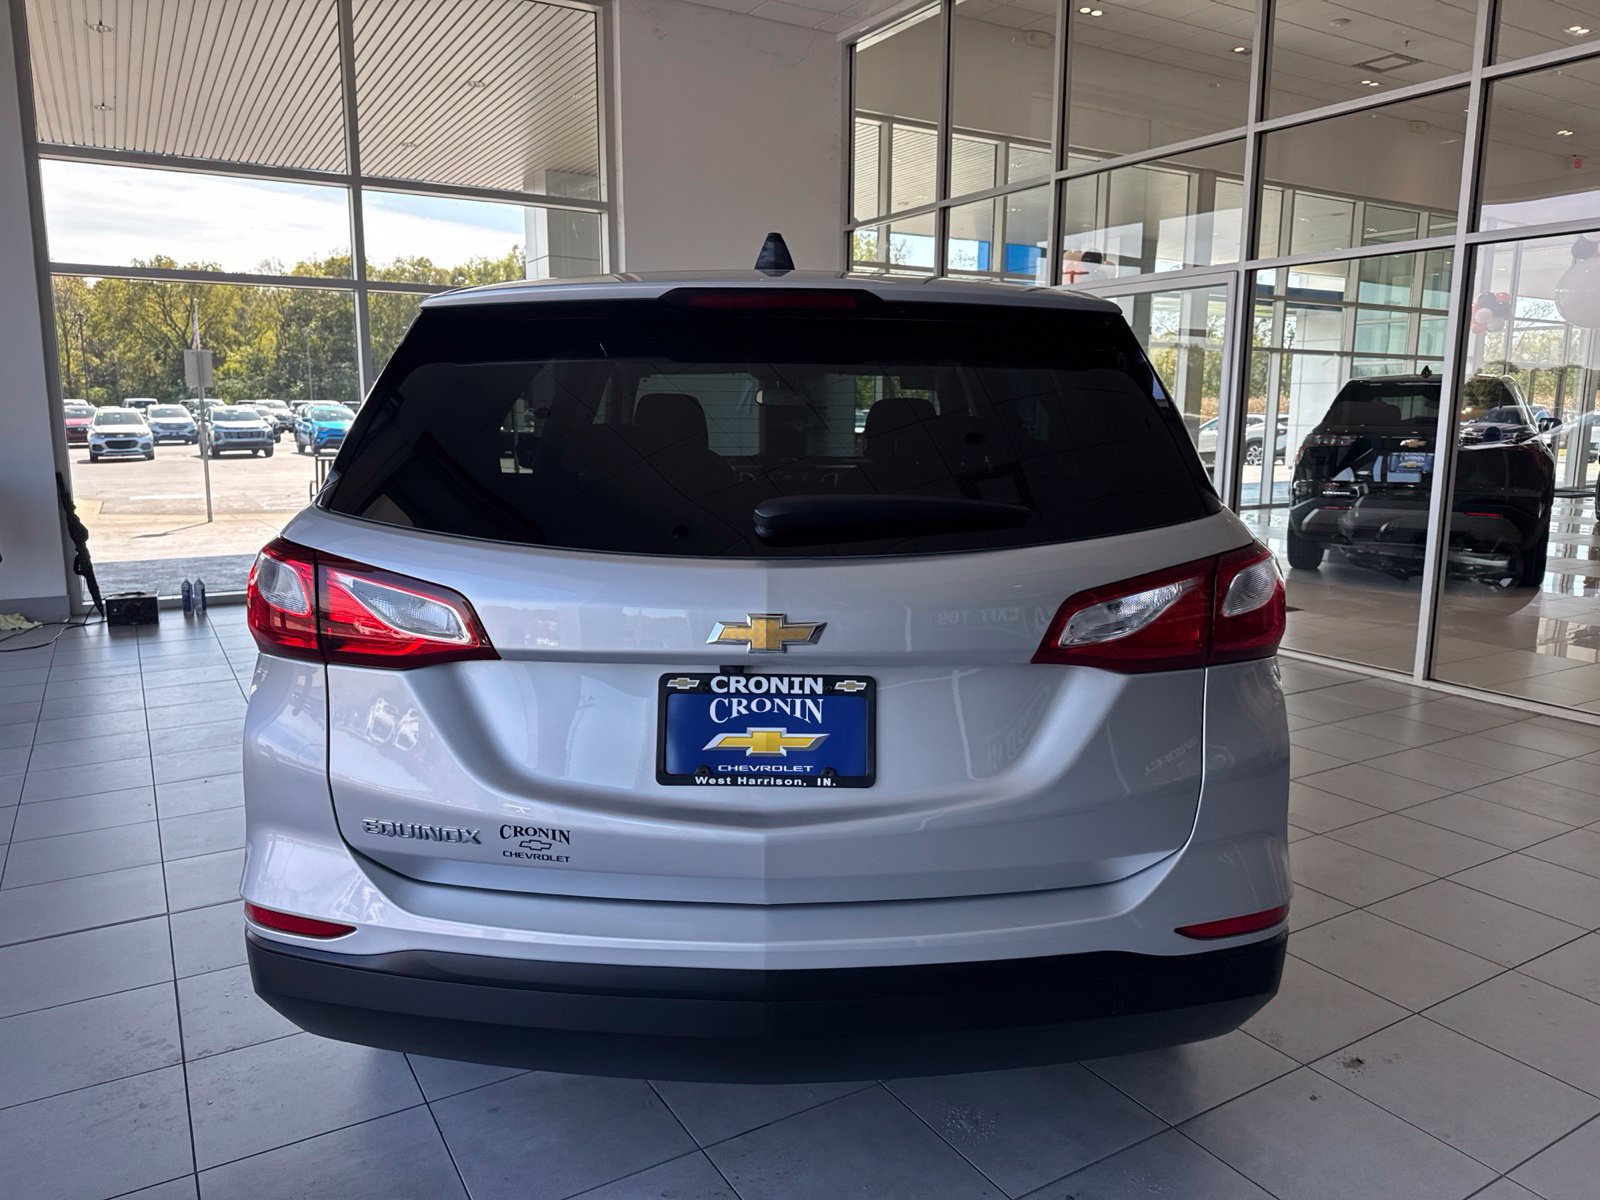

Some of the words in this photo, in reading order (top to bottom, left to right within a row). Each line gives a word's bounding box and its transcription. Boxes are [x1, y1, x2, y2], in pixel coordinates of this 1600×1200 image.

[709, 675, 824, 695] CRONIN
[709, 697, 824, 725] CRONIN
[717, 764, 814, 772] CHEVROLET
[694, 776, 732, 785] West
[737, 776, 807, 787] Harrison,
[817, 777, 837, 787] IN.
[361, 818, 482, 846] EQUINOX
[499, 823, 571, 846] CRONIN
[502, 850, 571, 863] CHEVROLET
